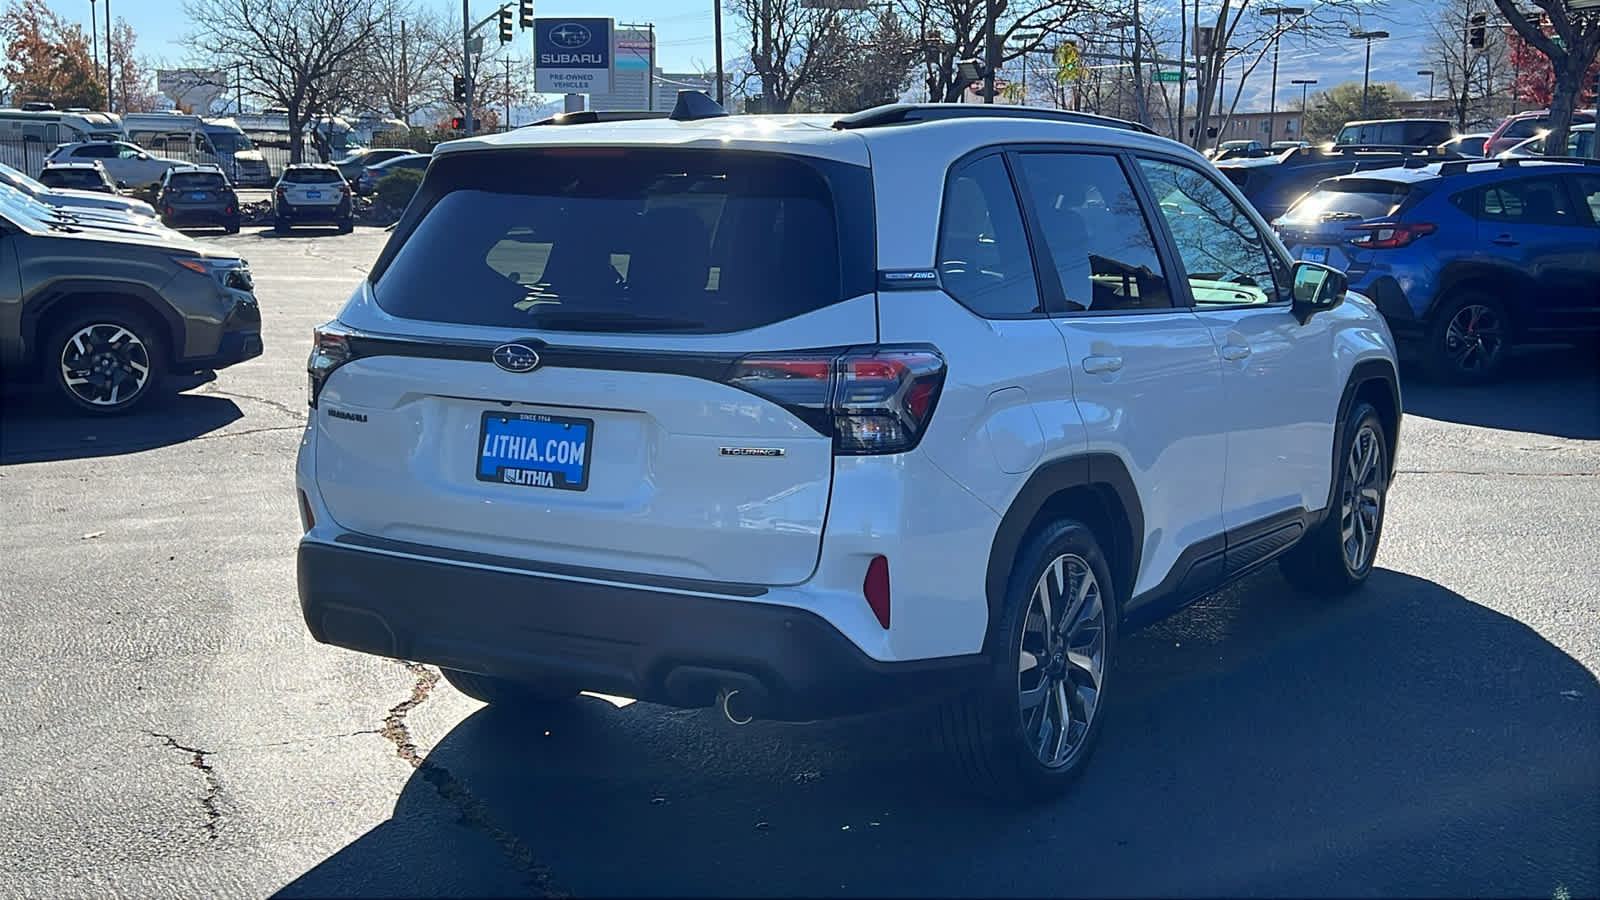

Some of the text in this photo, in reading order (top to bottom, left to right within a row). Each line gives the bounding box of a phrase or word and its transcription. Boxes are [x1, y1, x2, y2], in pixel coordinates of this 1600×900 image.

[541, 54, 602, 64] SUBARU
[549, 73, 594, 81] PRE-OWNED
[327, 409, 368, 423] SUBARU
[482, 433, 586, 466] LITHIA.COM
[726, 448, 777, 456] TOURING
[515, 469, 554, 487] LITHIA
